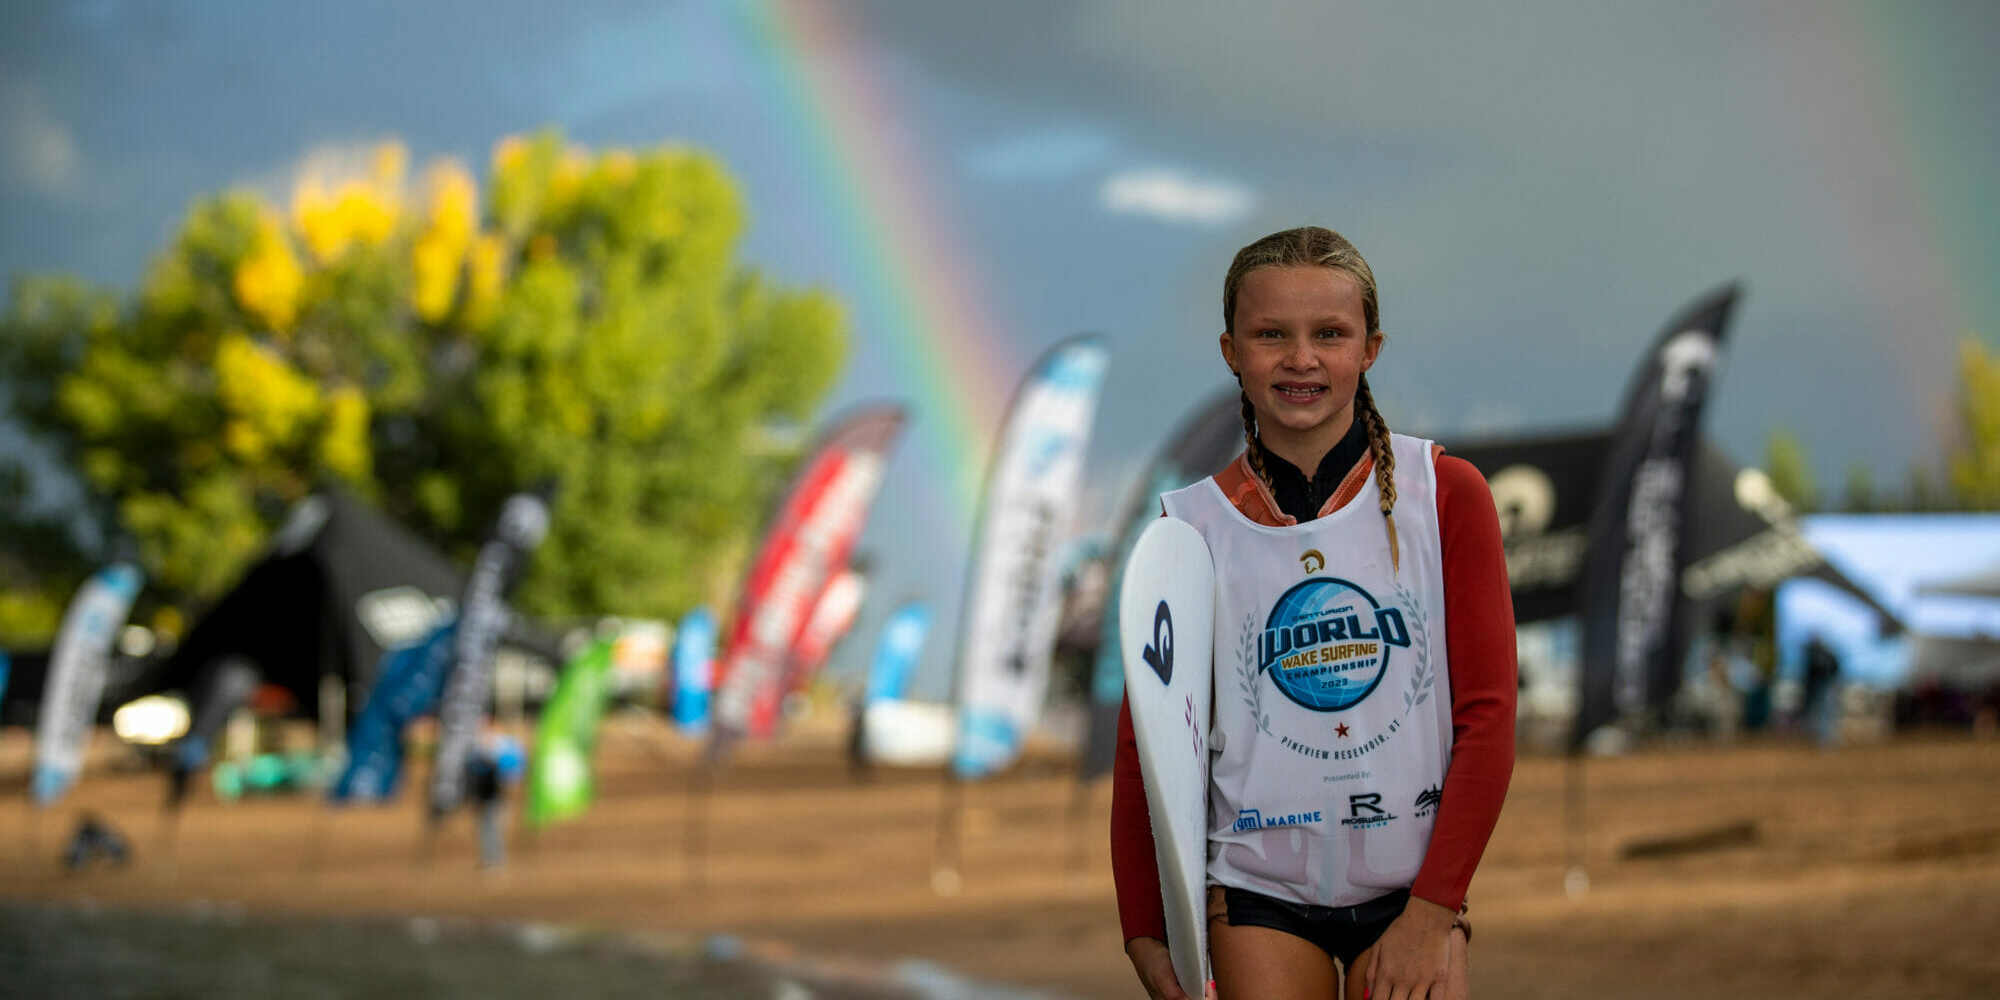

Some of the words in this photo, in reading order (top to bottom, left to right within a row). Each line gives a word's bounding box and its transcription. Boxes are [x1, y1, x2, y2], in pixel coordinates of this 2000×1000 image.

[1292, 606, 1353, 621] CENTURION
[1258, 608, 1411, 675] WORLD
[1281, 652, 1318, 670] WAKE
[1321, 643, 1377, 662] SURFING
[1287, 659, 1377, 679] CHAMPIONSHIP
[1281, 736, 1329, 760] PINEVIEW
[1388, 719, 1401, 733] UT
[1323, 772, 1360, 783] Presented
[1266, 811, 1322, 827] MARINE
[1341, 813, 1399, 826] ROSWELL
